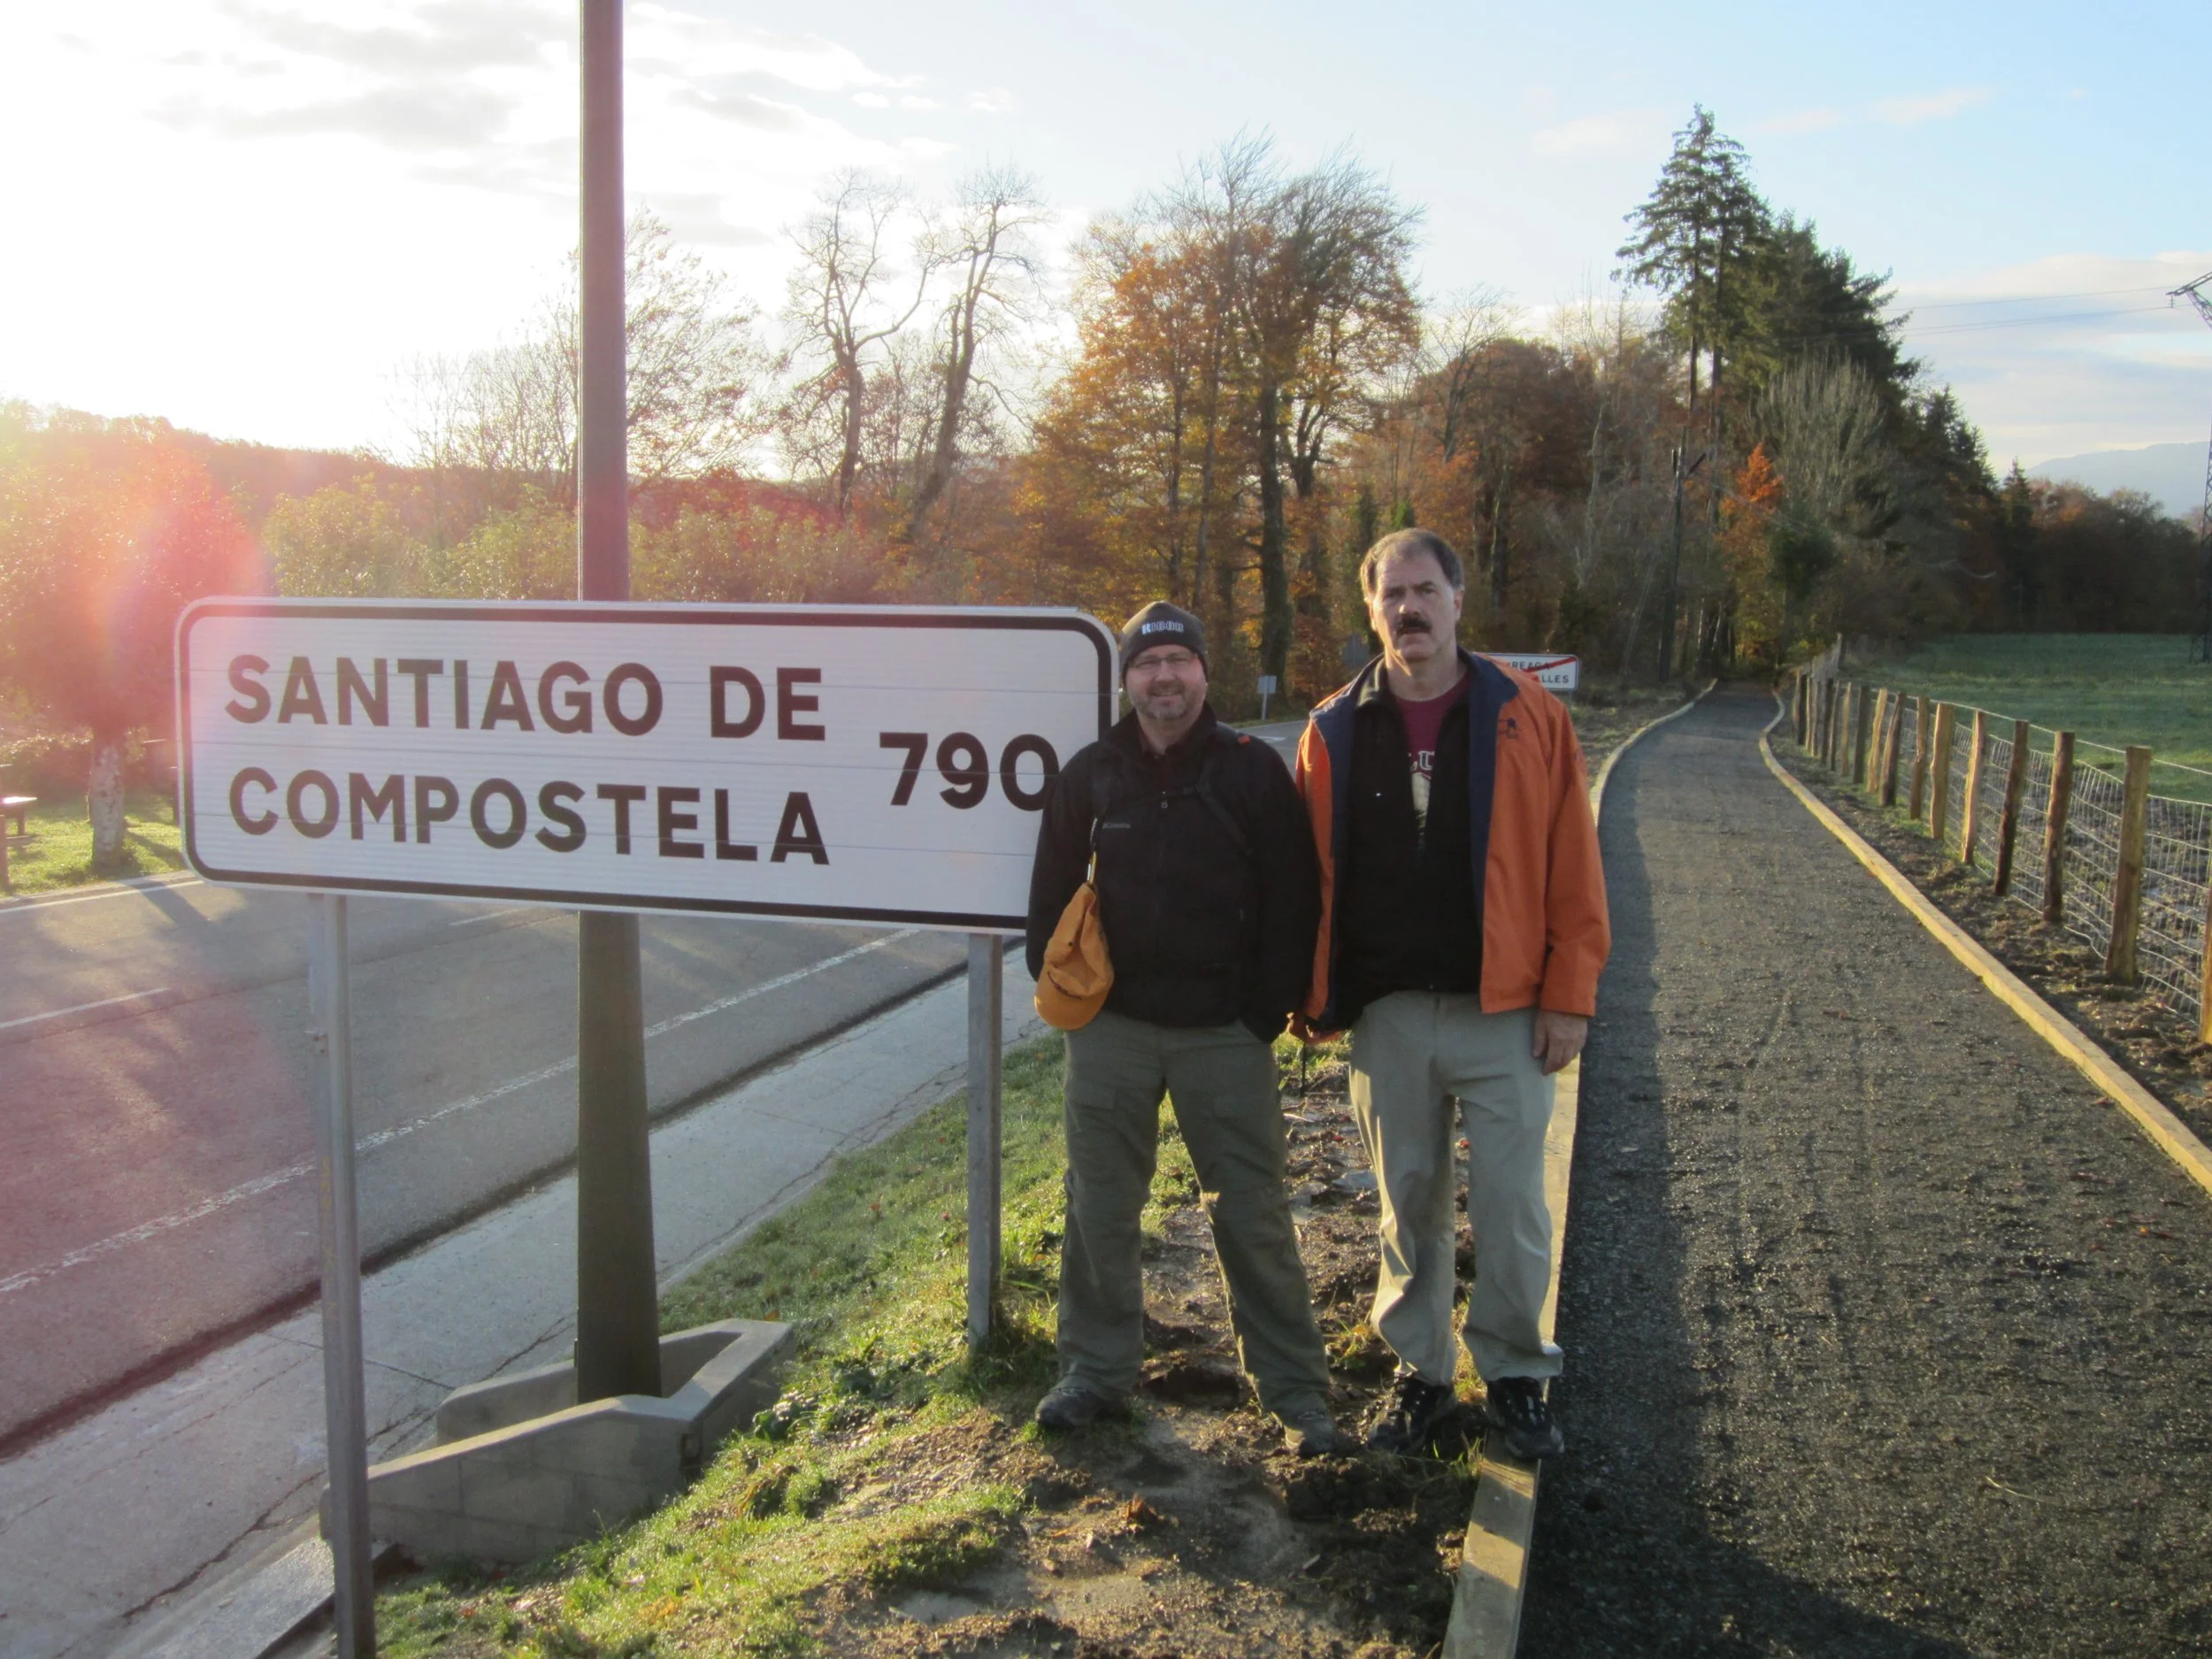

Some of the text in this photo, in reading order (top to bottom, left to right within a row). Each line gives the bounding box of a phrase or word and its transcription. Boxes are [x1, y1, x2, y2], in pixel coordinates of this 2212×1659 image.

[226, 654, 826, 741] SANTIAGO DE
[1541, 674, 1570, 684] LLES
[880, 733, 1060, 812] 790
[229, 767, 831, 866] COMPOSTELA
